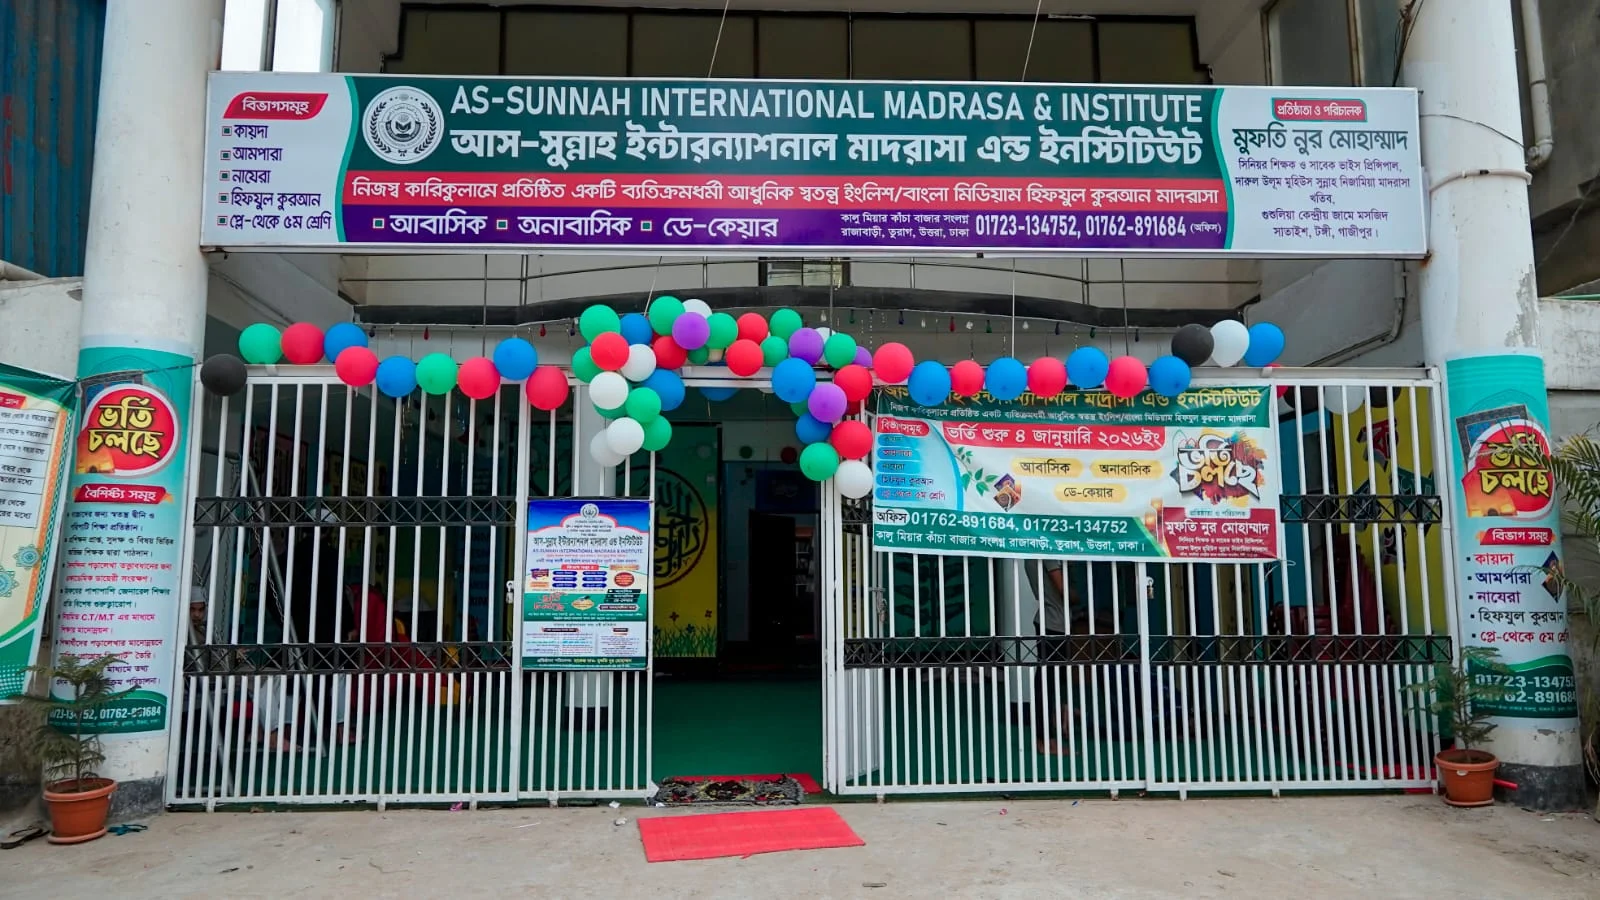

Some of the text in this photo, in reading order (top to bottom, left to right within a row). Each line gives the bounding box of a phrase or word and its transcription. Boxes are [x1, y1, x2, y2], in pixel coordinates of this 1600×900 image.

[242, 96, 310, 115] বিভাগসমূহ
[450, 85, 1203, 122] AS-SUNNAH INTERNATIONAL MADRASA & INSTITUTE
[1277, 102, 1363, 117] প্রতিষ্ঠাতা ও পরিচালক
[233, 124, 269, 140] কায়দা
[1232, 121, 1409, 156] মুফতি নুর মোহাম্মাদ
[449, 119, 1203, 170] আস-সুন্নাহ ইন্টারন্যাশনাল মাদরাসা এন্ড ইনস্টিটিউট
[232, 146, 283, 161] আমপারা
[1238, 158, 1268, 170] সিনিয়র
[1270, 158, 1296, 170] শিক্ষক
[1299, 162, 1306, 170] ও
[1309, 161, 1336, 171] সাবেক
[1339, 159, 1361, 171] ভাইস
[232, 169, 272, 184] নাযেরা
[1235, 176, 1259, 187] দারুল
[1285, 174, 1313, 188] মুহিউস
[1316, 177, 1338, 189] সুন্নাহ
[1340, 175, 1376, 188] নিজামিয়া
[1379, 177, 1410, 188] মাদরাসা
[231, 186, 321, 210] হিফযুল কুরআন
[352, 176, 1220, 207] নিজস্ব কারিকুলামে প্রতিষ্ঠিত একটি ব্যতিক্রমধর্মী আধুনিক স্বতন্ত্র ইংলিশ/বাংলা মিডিয়াম হিফযুল কুরআন মাদরাসা
[283, 215, 303, 229] ৫ম
[306, 210, 332, 230] শ্রেণি
[840, 211, 970, 224] কালু মিয়ার কাঁচা বাজার সংলগ্ন
[1298, 207, 1329, 222] কেন্দ্রীয়
[1332, 210, 1354, 221] জামে
[1357, 208, 1388, 221] মসজিদ
[389, 207, 779, 240] আবাসিক অনাবাসিক ডে-কেয়ার
[840, 225, 970, 239] রাজাবাড়ী, তুরাগ, উত্তরা, ঢাকা
[975, 214, 1222, 240] 01723-134752, 01762-891684 (অফিস)
[1273, 225, 1312, 239] সাতাইশ,
[99, 396, 156, 428] ভর্তি
[88, 428, 164, 459] চলছে
[945, 422, 1161, 448] ভর্তি শুরু ৪ জানুয়ারি ২০২৬ইং
[1019, 458, 1071, 475] আবাসিক
[1099, 462, 1151, 476] অনাবাসিক
[1479, 469, 1551, 497] চলছে
[85, 486, 157, 502] বৈশিষ্ট্য সমূহ
[876, 509, 1128, 534] অফিস 01762-891684, 01723-134752
[1165, 518, 1271, 536] মুফতি নুর মোহাম্মাদ
[876, 528, 1115, 552] কালু মিয়ার কাঁচা বাজার সংলগ্ন রাজাবাড়ী, তুরাগ, উত্তরা,
[1492, 529, 1549, 543] বিভাগ সমূহ
[1474, 553, 1515, 566] কায়দা
[1475, 572, 1533, 585] আমপারা
[1476, 591, 1521, 604] নাযেরা
[1478, 607, 1525, 626] হিফযুল
[1539, 631, 1555, 643] ৫ম
